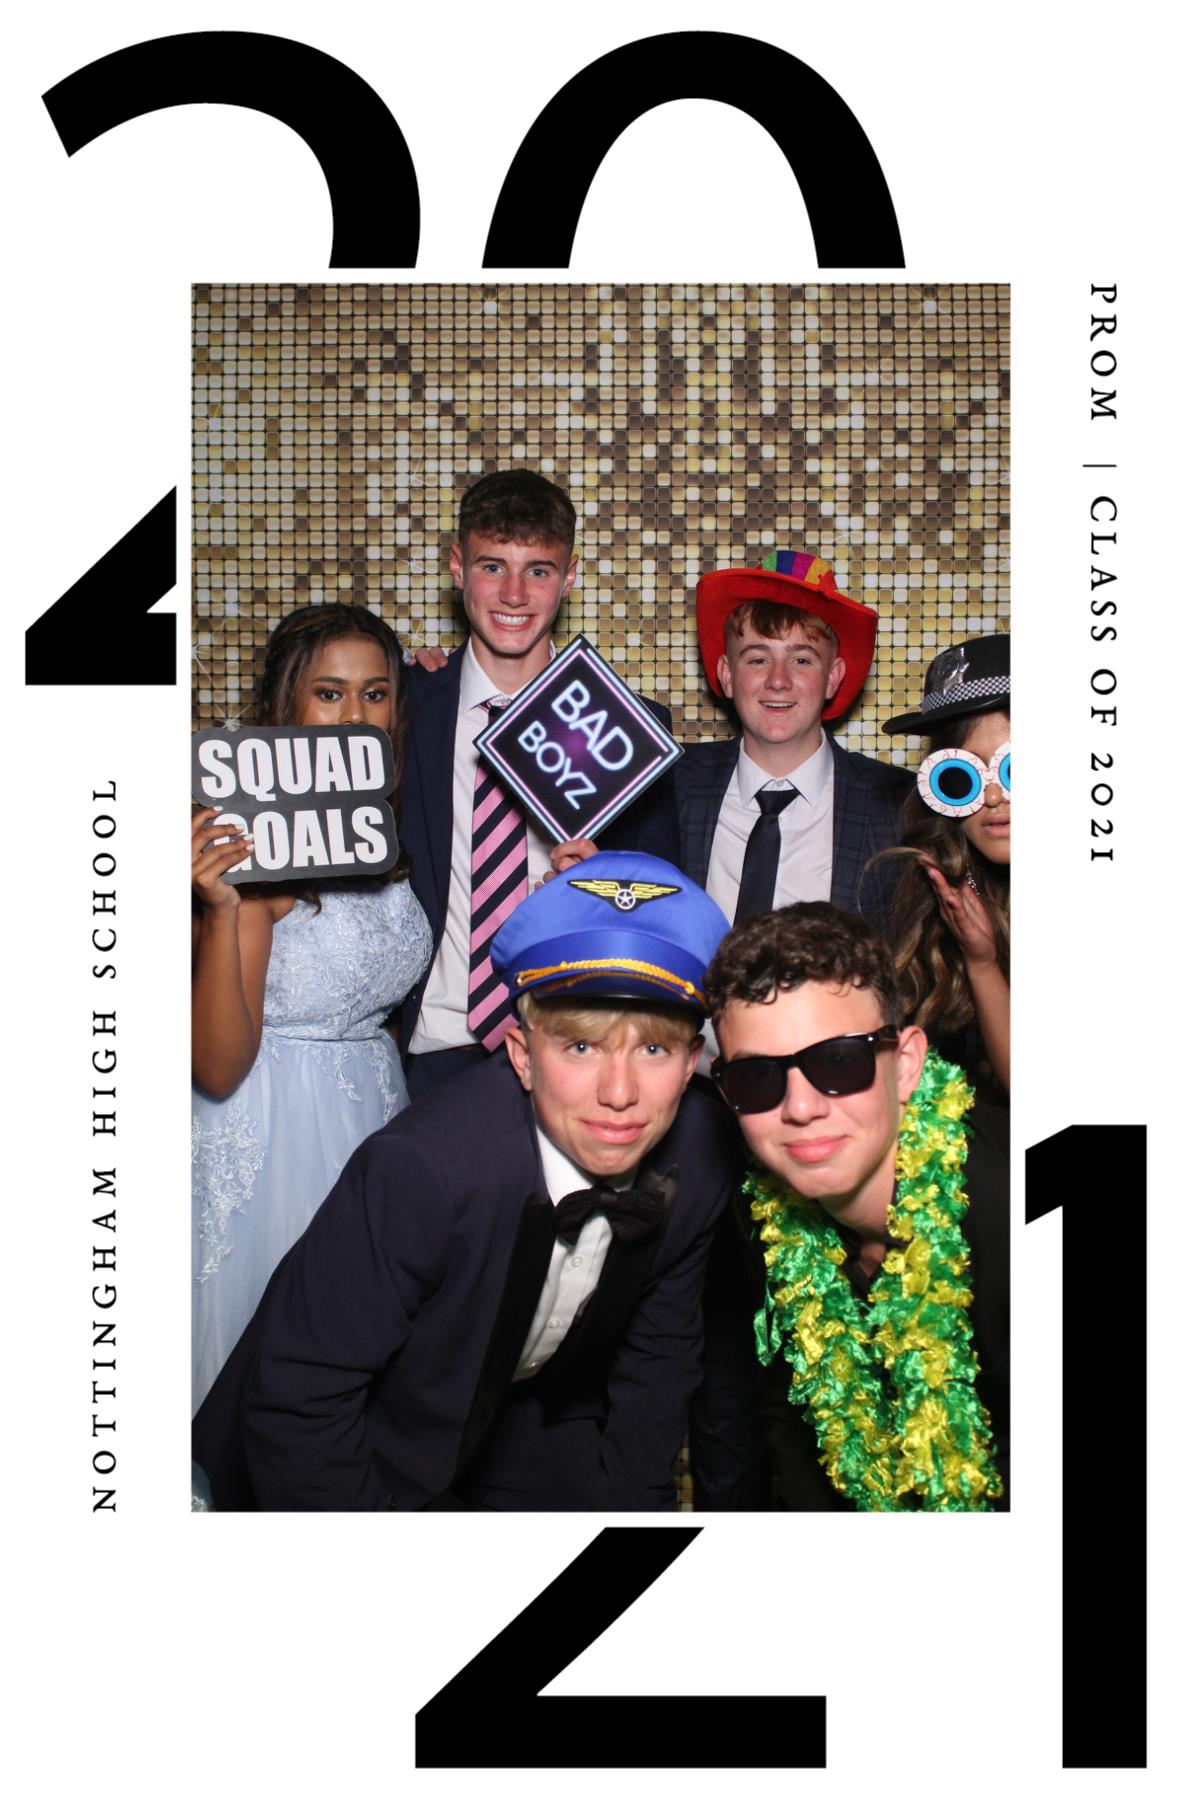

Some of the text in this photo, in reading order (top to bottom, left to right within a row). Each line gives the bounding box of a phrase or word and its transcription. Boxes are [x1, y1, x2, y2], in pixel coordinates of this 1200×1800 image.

[198, 735, 386, 802] SQUAD
[517, 720, 597, 810] BOYZ
[551, 679, 634, 771] BAD
